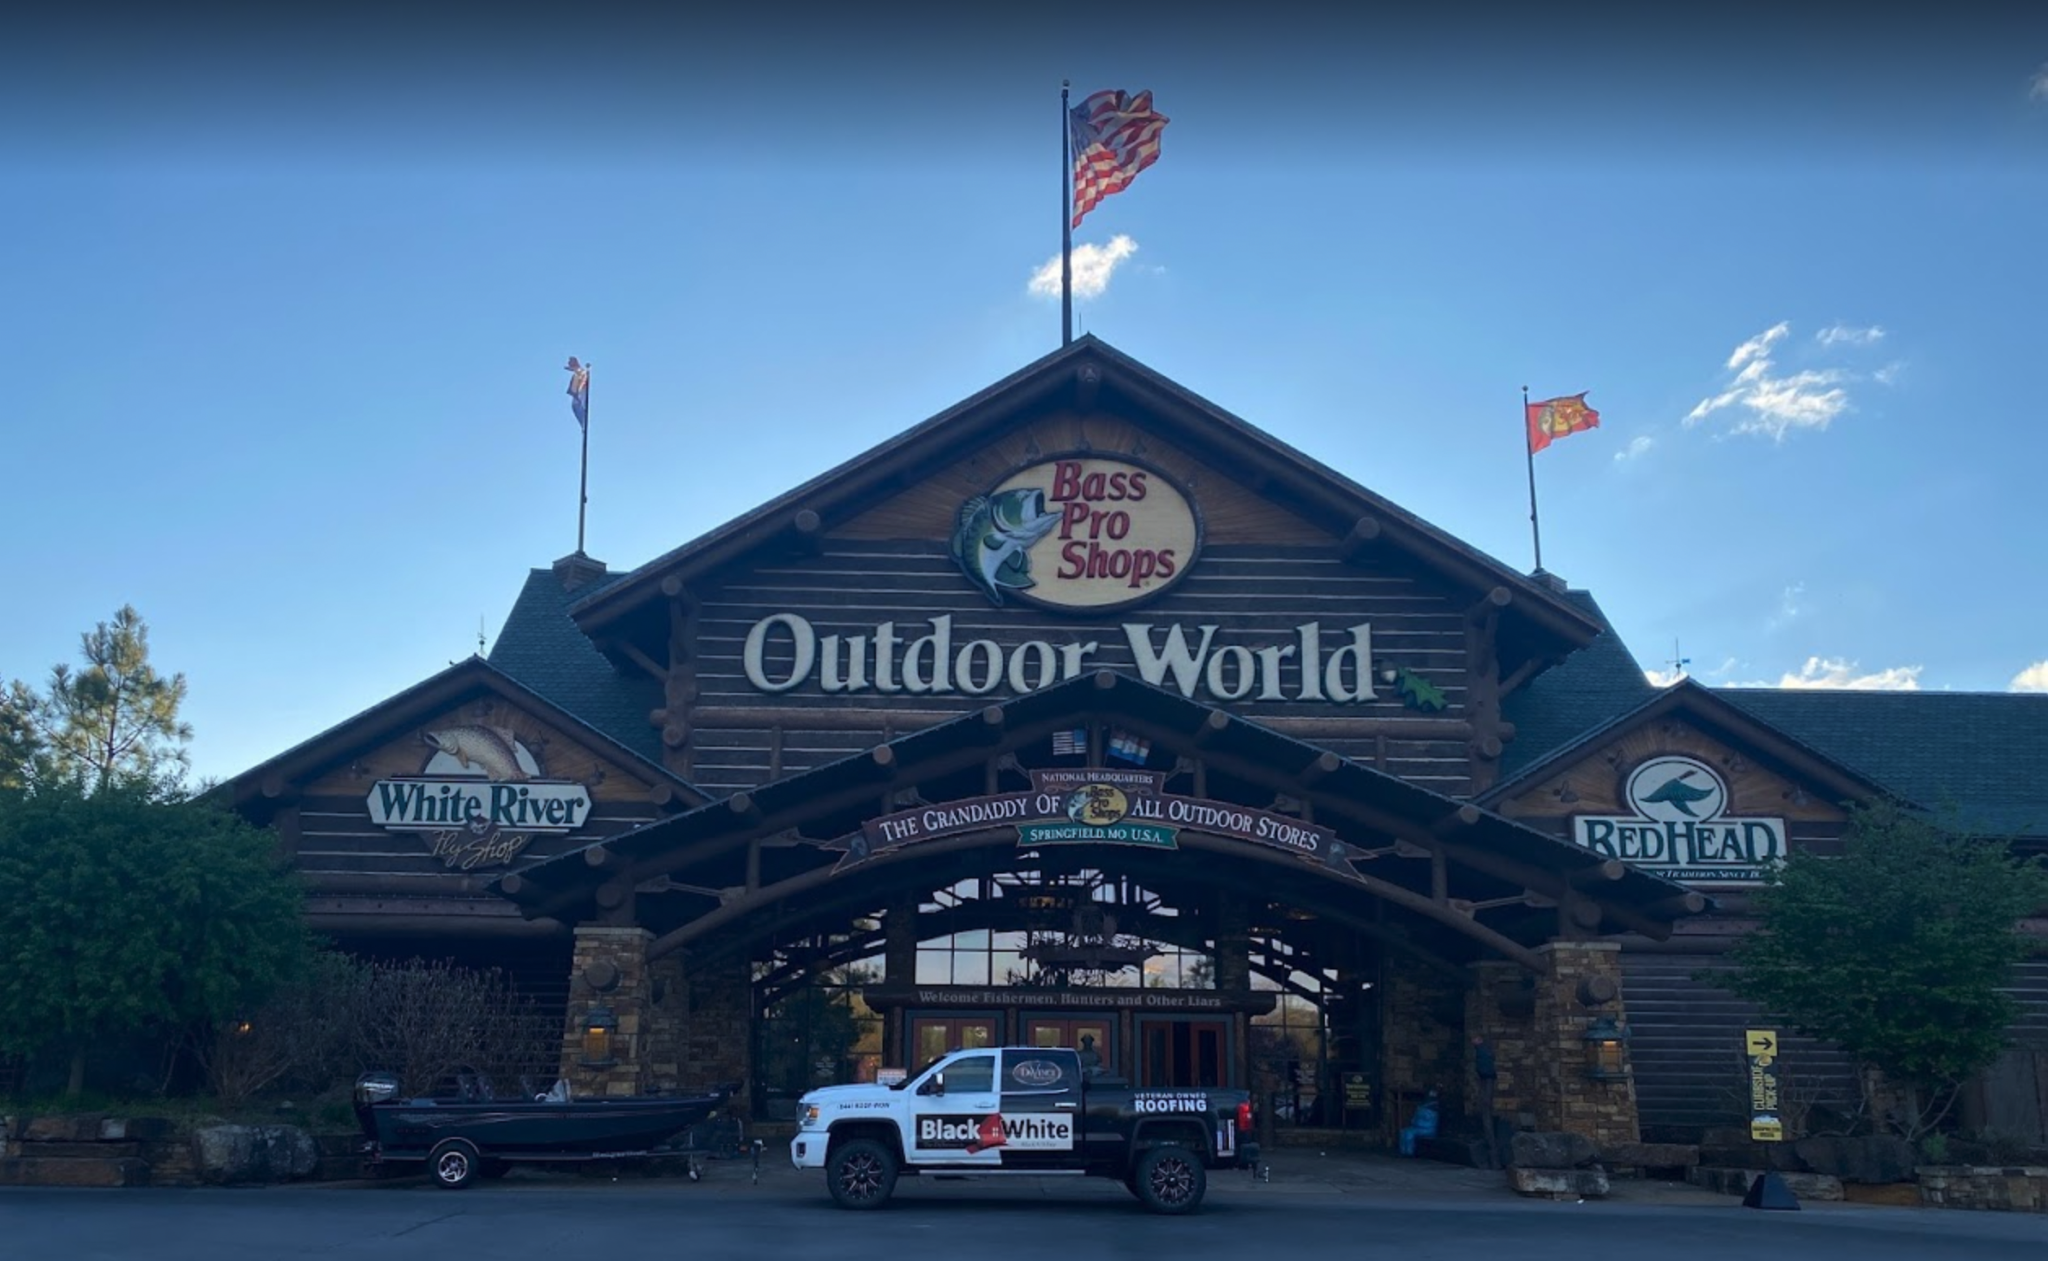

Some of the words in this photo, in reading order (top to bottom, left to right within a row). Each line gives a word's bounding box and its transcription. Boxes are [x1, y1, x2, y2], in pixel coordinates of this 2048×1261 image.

[1050, 461, 1148, 501] Bass
[1059, 501, 1130, 541] Pro
[1056, 540, 1175, 586] Shops
[742, 612, 1098, 694] Outdoor
[1121, 621, 1379, 702] World
[1041, 772, 1086, 783] NATIONAL
[1087, 772, 1153, 784] HEADQUARTERS
[377, 782, 482, 824] White
[490, 785, 584, 827] River
[879, 817, 918, 842] THE
[923, 798, 1027, 831] GRANDADDY
[1036, 793, 1060, 814] OF
[1131, 797, 1163, 818] ALL
[1169, 800, 1253, 832] OUTDOOR
[1256, 816, 1320, 851] STORES
[431, 829, 461, 869] Fly
[461, 833, 528, 870] Shop
[1108, 829, 1127, 840] MO
[1584, 819, 1778, 865] REDHEAD
[919, 990, 979, 1003] Welcome
[1061, 993, 1115, 1005] Hunters
[1117, 994, 1142, 1005] and
[1147, 994, 1183, 1006] Other
[1188, 995, 1221, 1007] Liars
[1134, 1099, 1207, 1113] ROOFING
[1176, 1091, 1207, 1099] OWNED
[921, 1118, 981, 1140] Black
[1001, 1118, 1069, 1139] White
